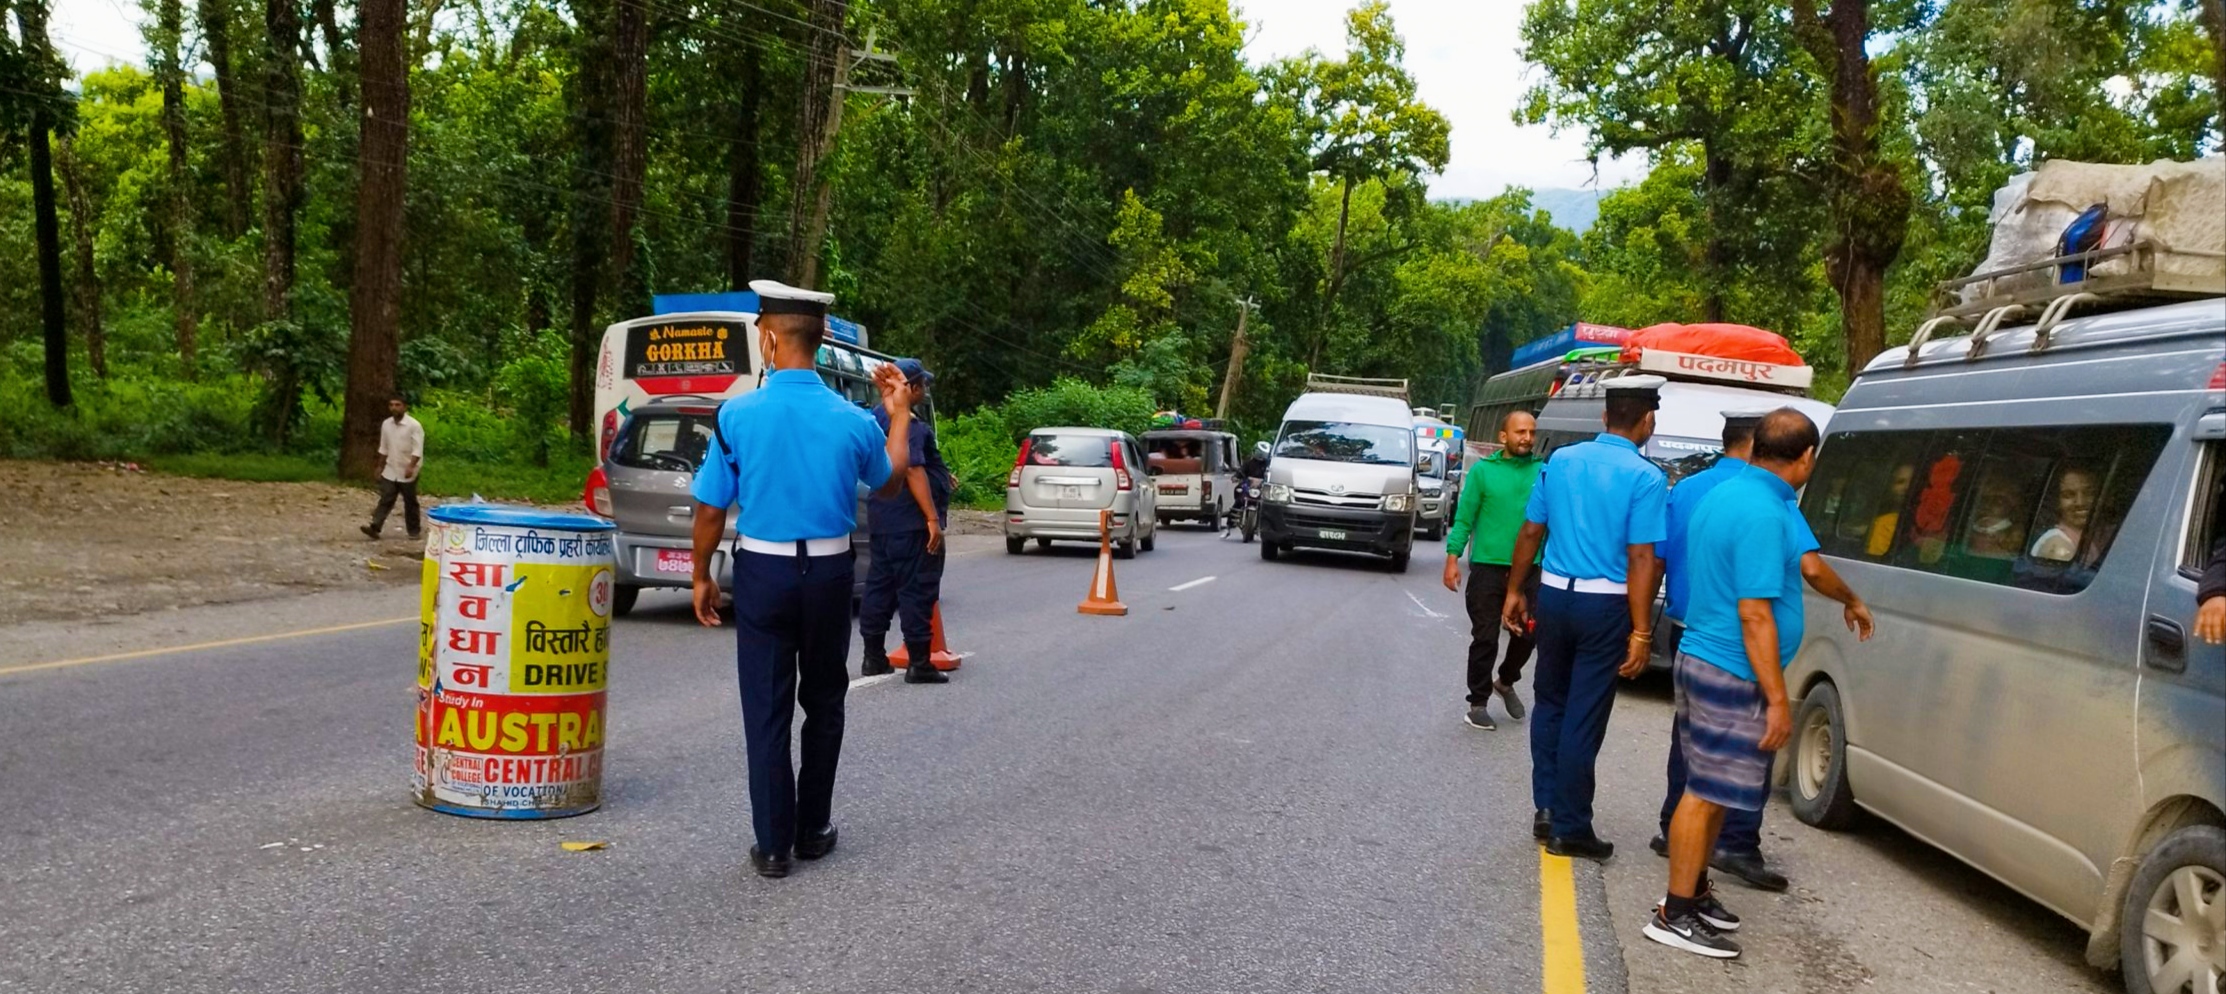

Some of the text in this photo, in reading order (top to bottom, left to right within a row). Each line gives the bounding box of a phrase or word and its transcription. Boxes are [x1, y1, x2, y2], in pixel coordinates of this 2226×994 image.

[663, 325, 714, 339] Namaste
[646, 341, 726, 362] GORKHA
[1678, 356, 1777, 381] पदमपुर
[475, 527, 512, 553] जिल्ला
[515, 530, 556, 558] ट्राफिक
[559, 534, 583, 558] प्रहरी
[595, 581, 609, 604] 30
[525, 620, 591, 655] विस्तारै
[524, 662, 598, 686] DRIVE
[439, 692, 484, 709] Study In
[452, 769, 482, 784] COLLEGE
[484, 756, 583, 785] CENTRAL
[483, 785, 499, 797] OF
[503, 785, 568, 798] VOCATION
